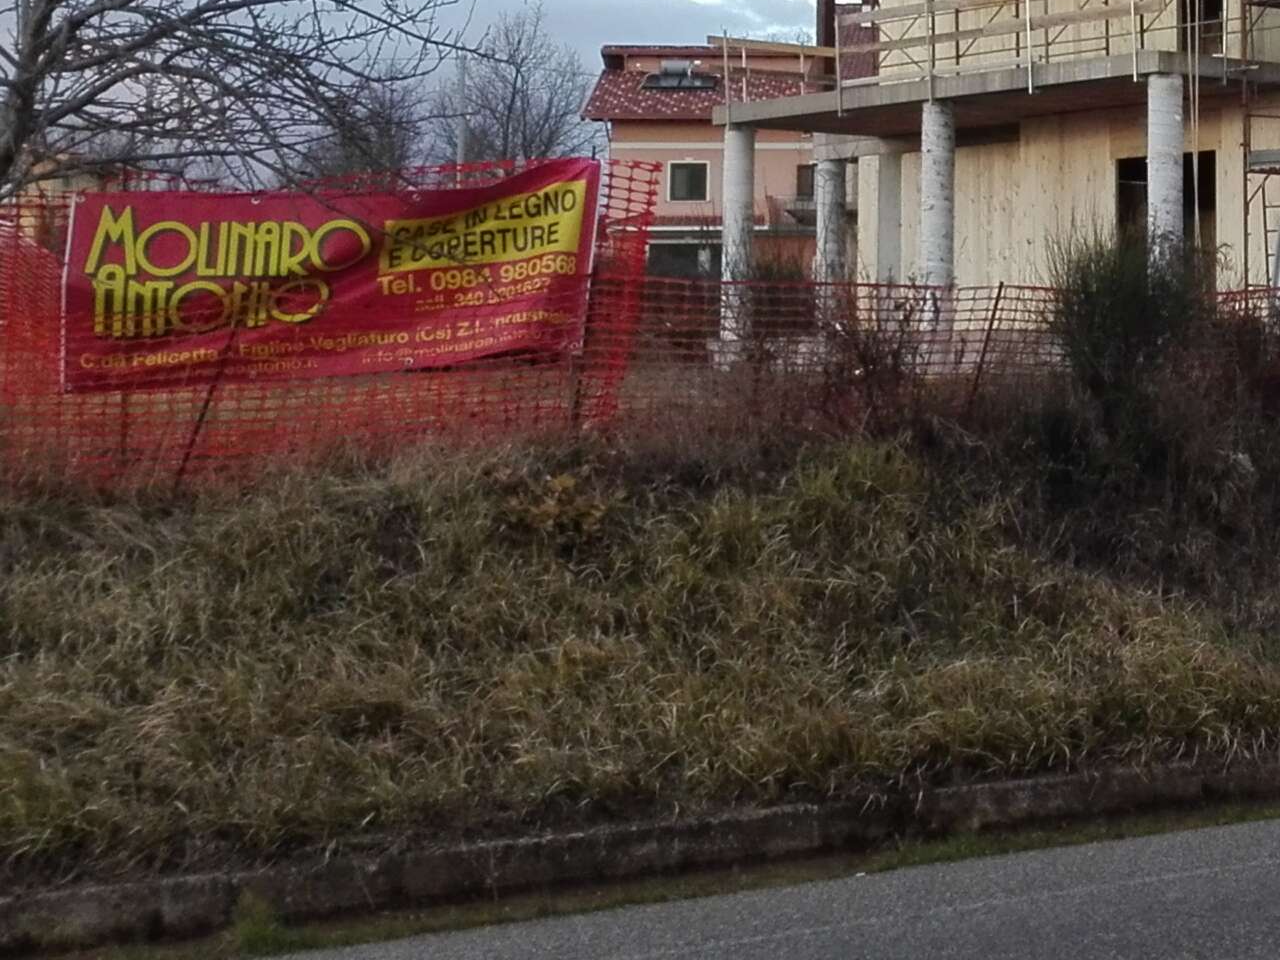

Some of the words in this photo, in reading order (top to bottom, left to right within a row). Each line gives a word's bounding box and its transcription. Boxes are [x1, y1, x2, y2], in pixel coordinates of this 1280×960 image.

[494, 189, 577, 220] LEGNO
[389, 247, 403, 269] E
[410, 221, 560, 262] COPERTURE
[377, 273, 422, 296] Tel.
[501, 254, 577, 283] 980568
